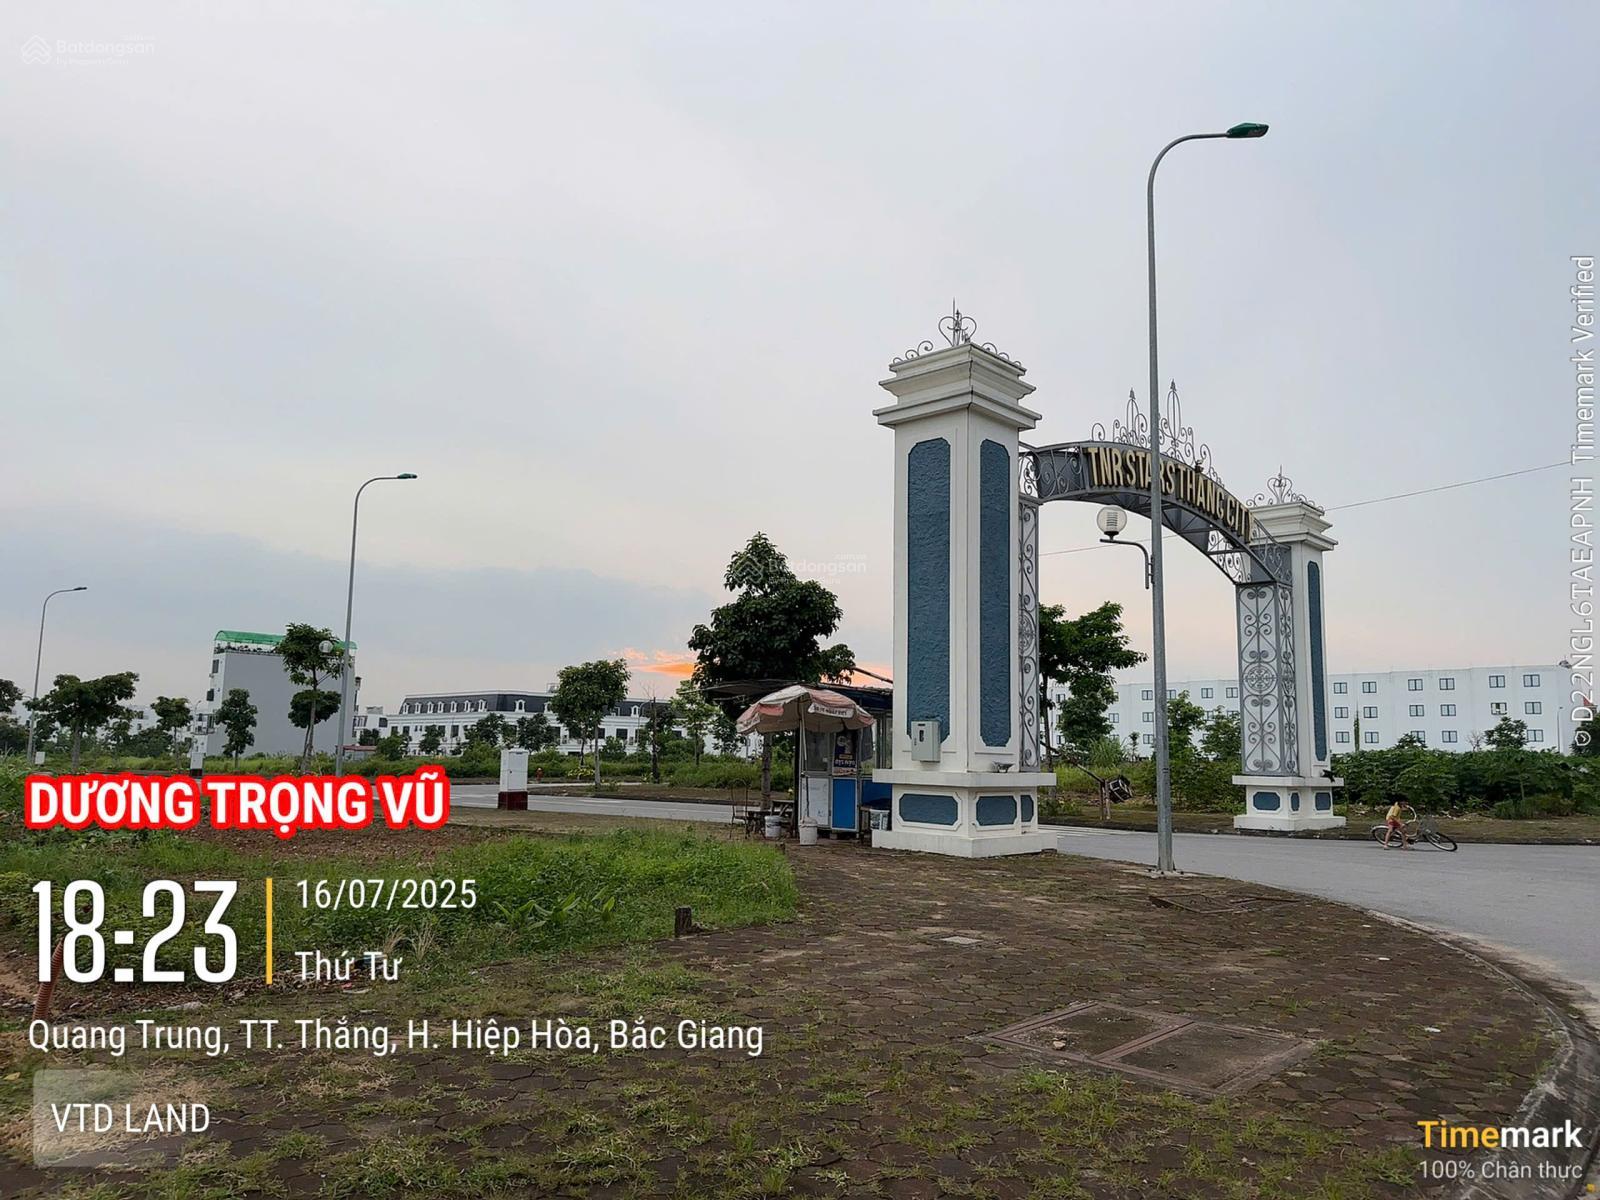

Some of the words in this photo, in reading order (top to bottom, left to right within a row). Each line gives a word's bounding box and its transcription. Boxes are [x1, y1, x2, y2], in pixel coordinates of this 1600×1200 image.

[1088, 447, 1124, 487] TNR
[1126, 449, 1175, 495] STARS
[1178, 465, 1225, 520] THANG
